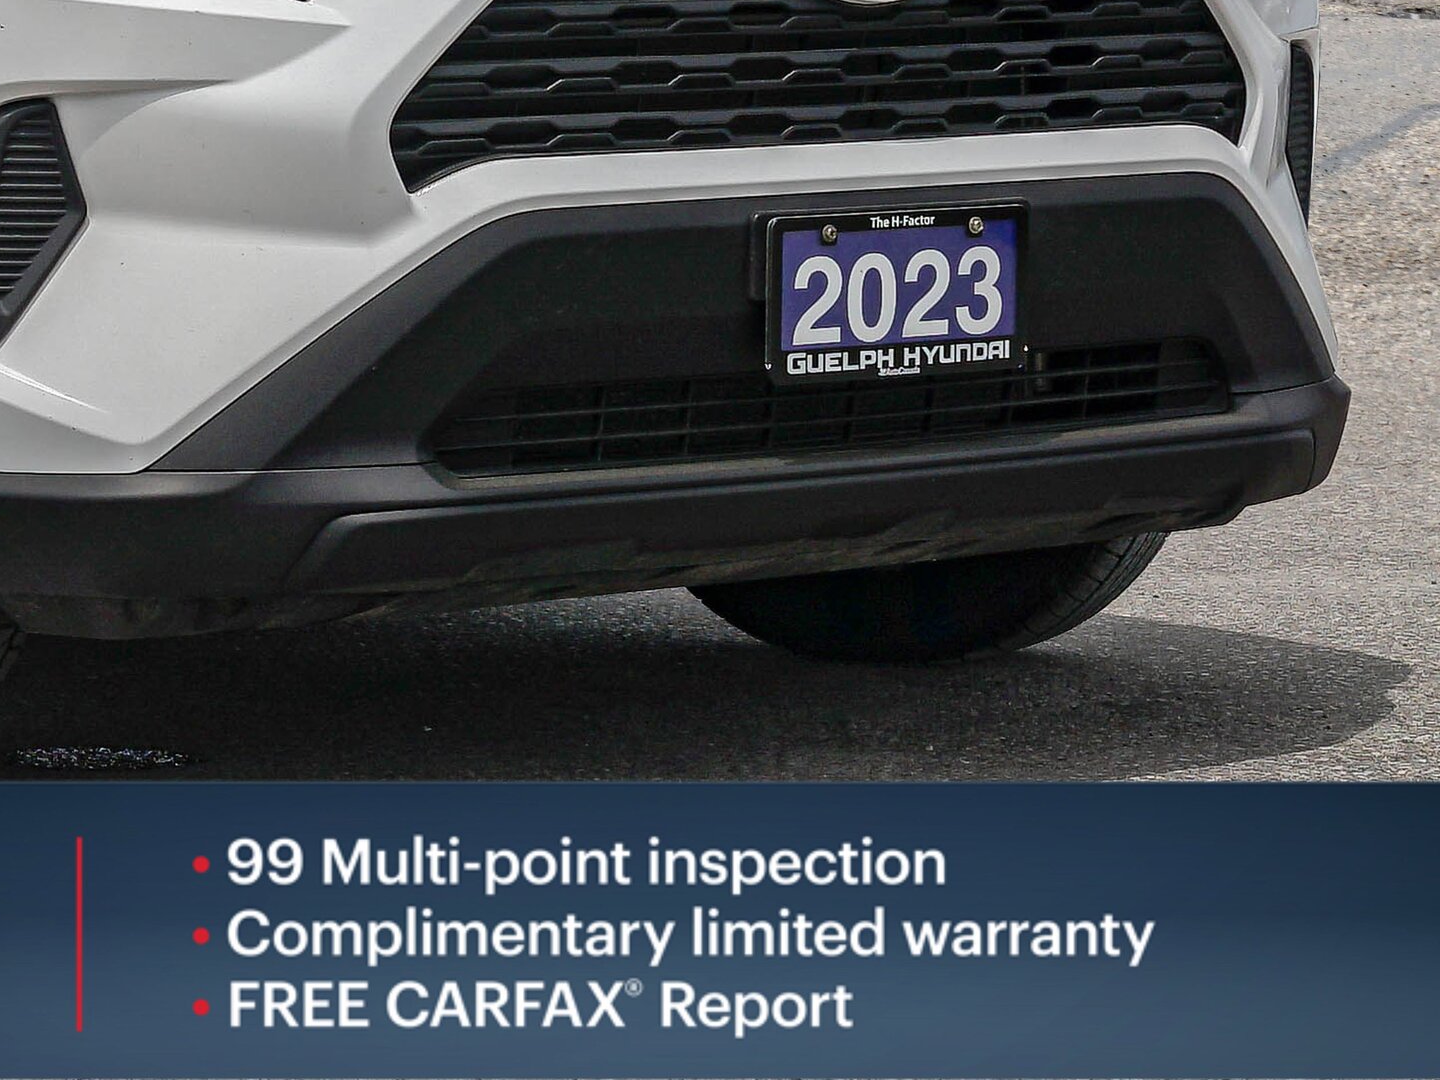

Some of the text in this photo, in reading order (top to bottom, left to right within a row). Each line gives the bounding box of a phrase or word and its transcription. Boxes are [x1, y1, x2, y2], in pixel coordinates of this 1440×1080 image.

[870, 215, 935, 230] The H-Factor
[792, 245, 1003, 346] 2023
[786, 339, 1010, 375] GUELPH HYUNDAI
